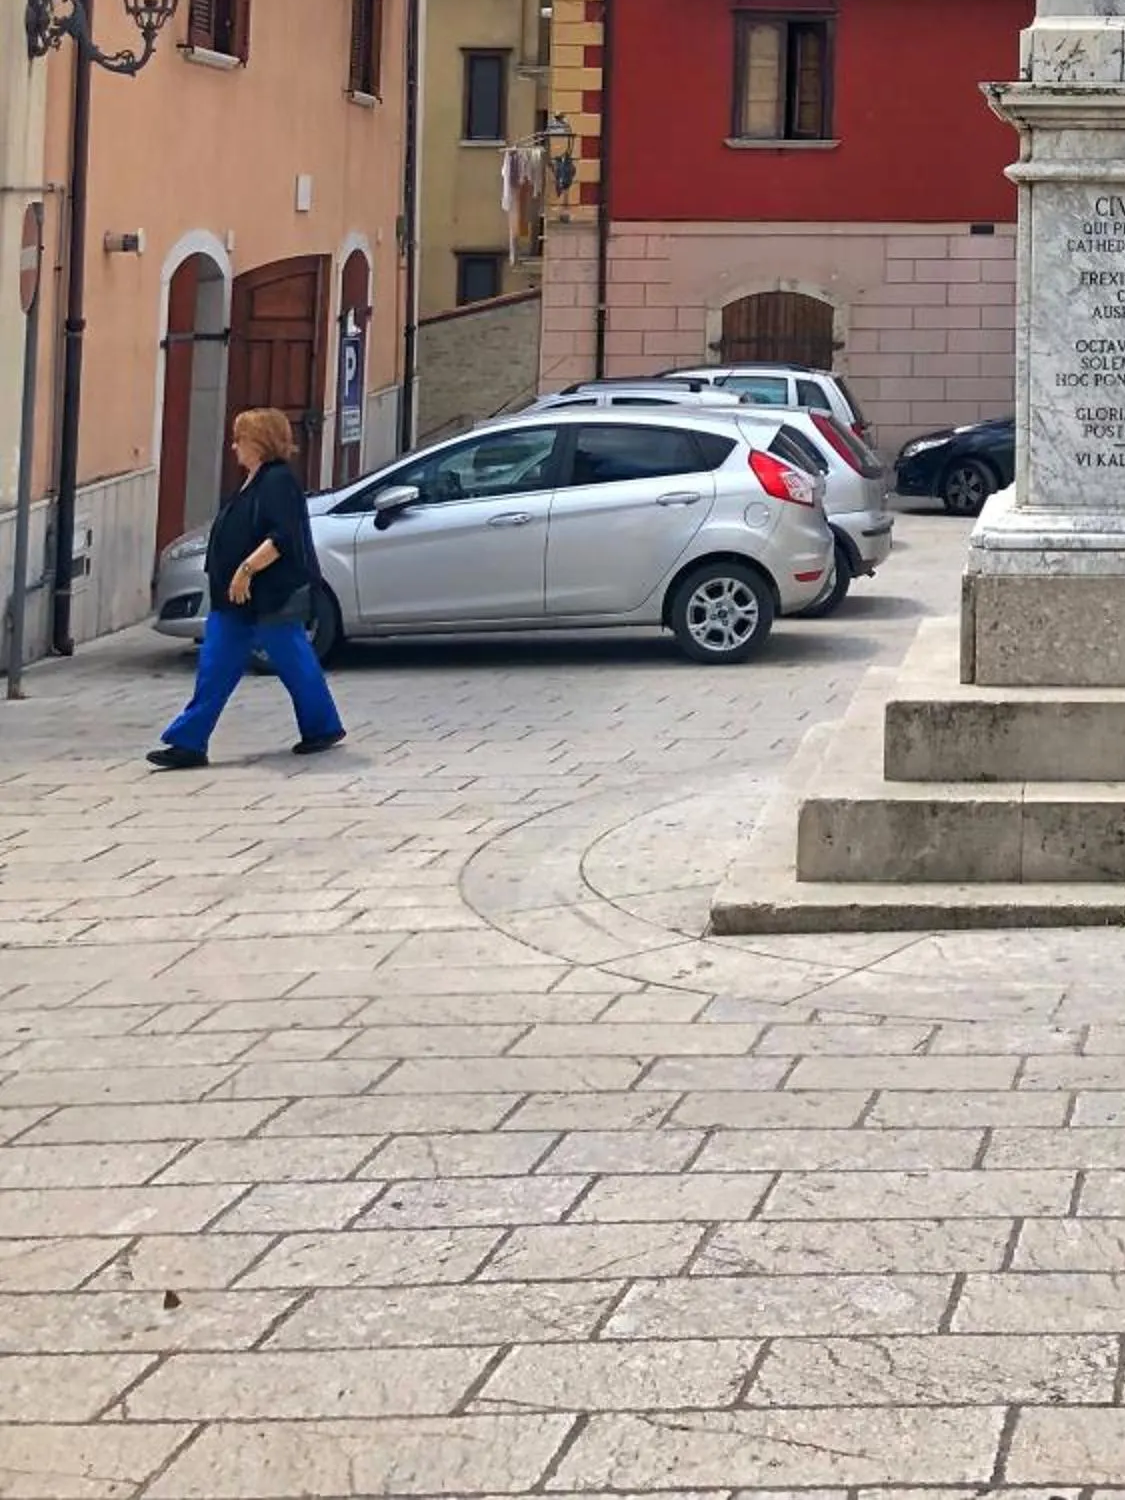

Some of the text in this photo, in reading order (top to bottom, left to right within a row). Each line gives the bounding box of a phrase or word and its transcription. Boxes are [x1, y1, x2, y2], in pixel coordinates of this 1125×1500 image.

[1083, 222, 1107, 235] QUI
[345, 345, 357, 398] P
[1055, 373, 1090, 387] HOC
[1075, 453, 1091, 467] VI
